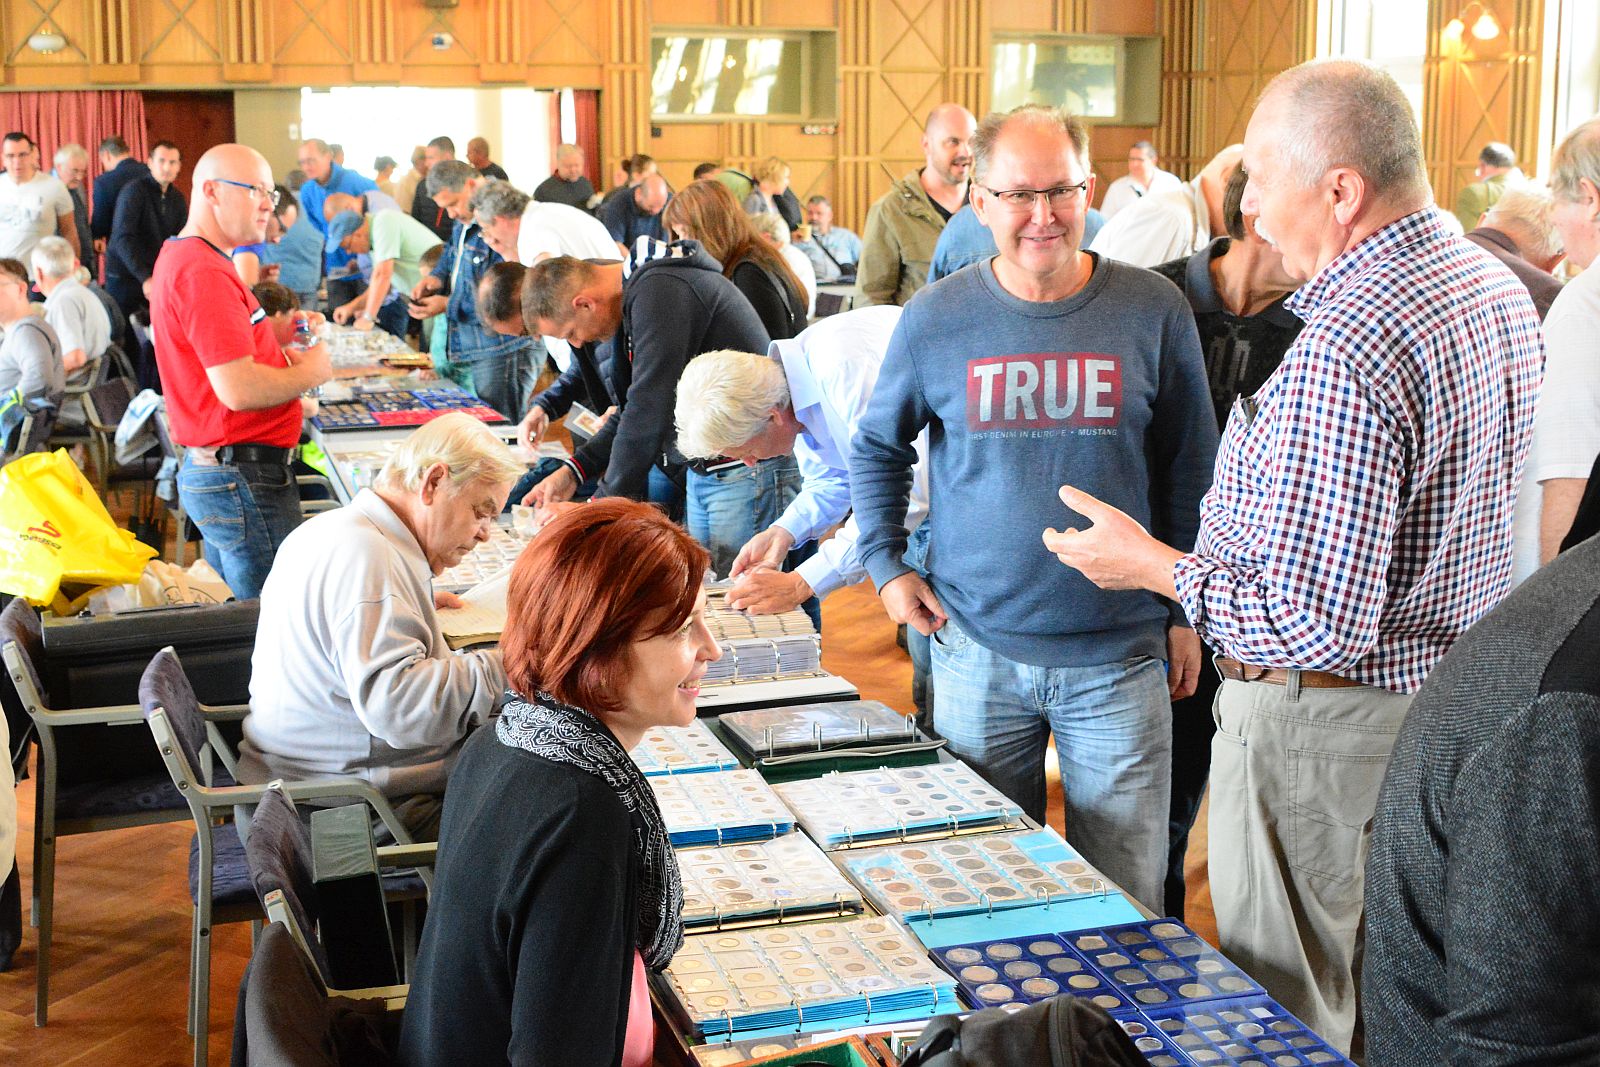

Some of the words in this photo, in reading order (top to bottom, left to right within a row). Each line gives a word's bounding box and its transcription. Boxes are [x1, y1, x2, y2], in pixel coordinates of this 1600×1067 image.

[973, 359, 1115, 422] TRUE
[990, 431, 1017, 439] DENIM
[1078, 428, 1118, 436] MUSTANG
